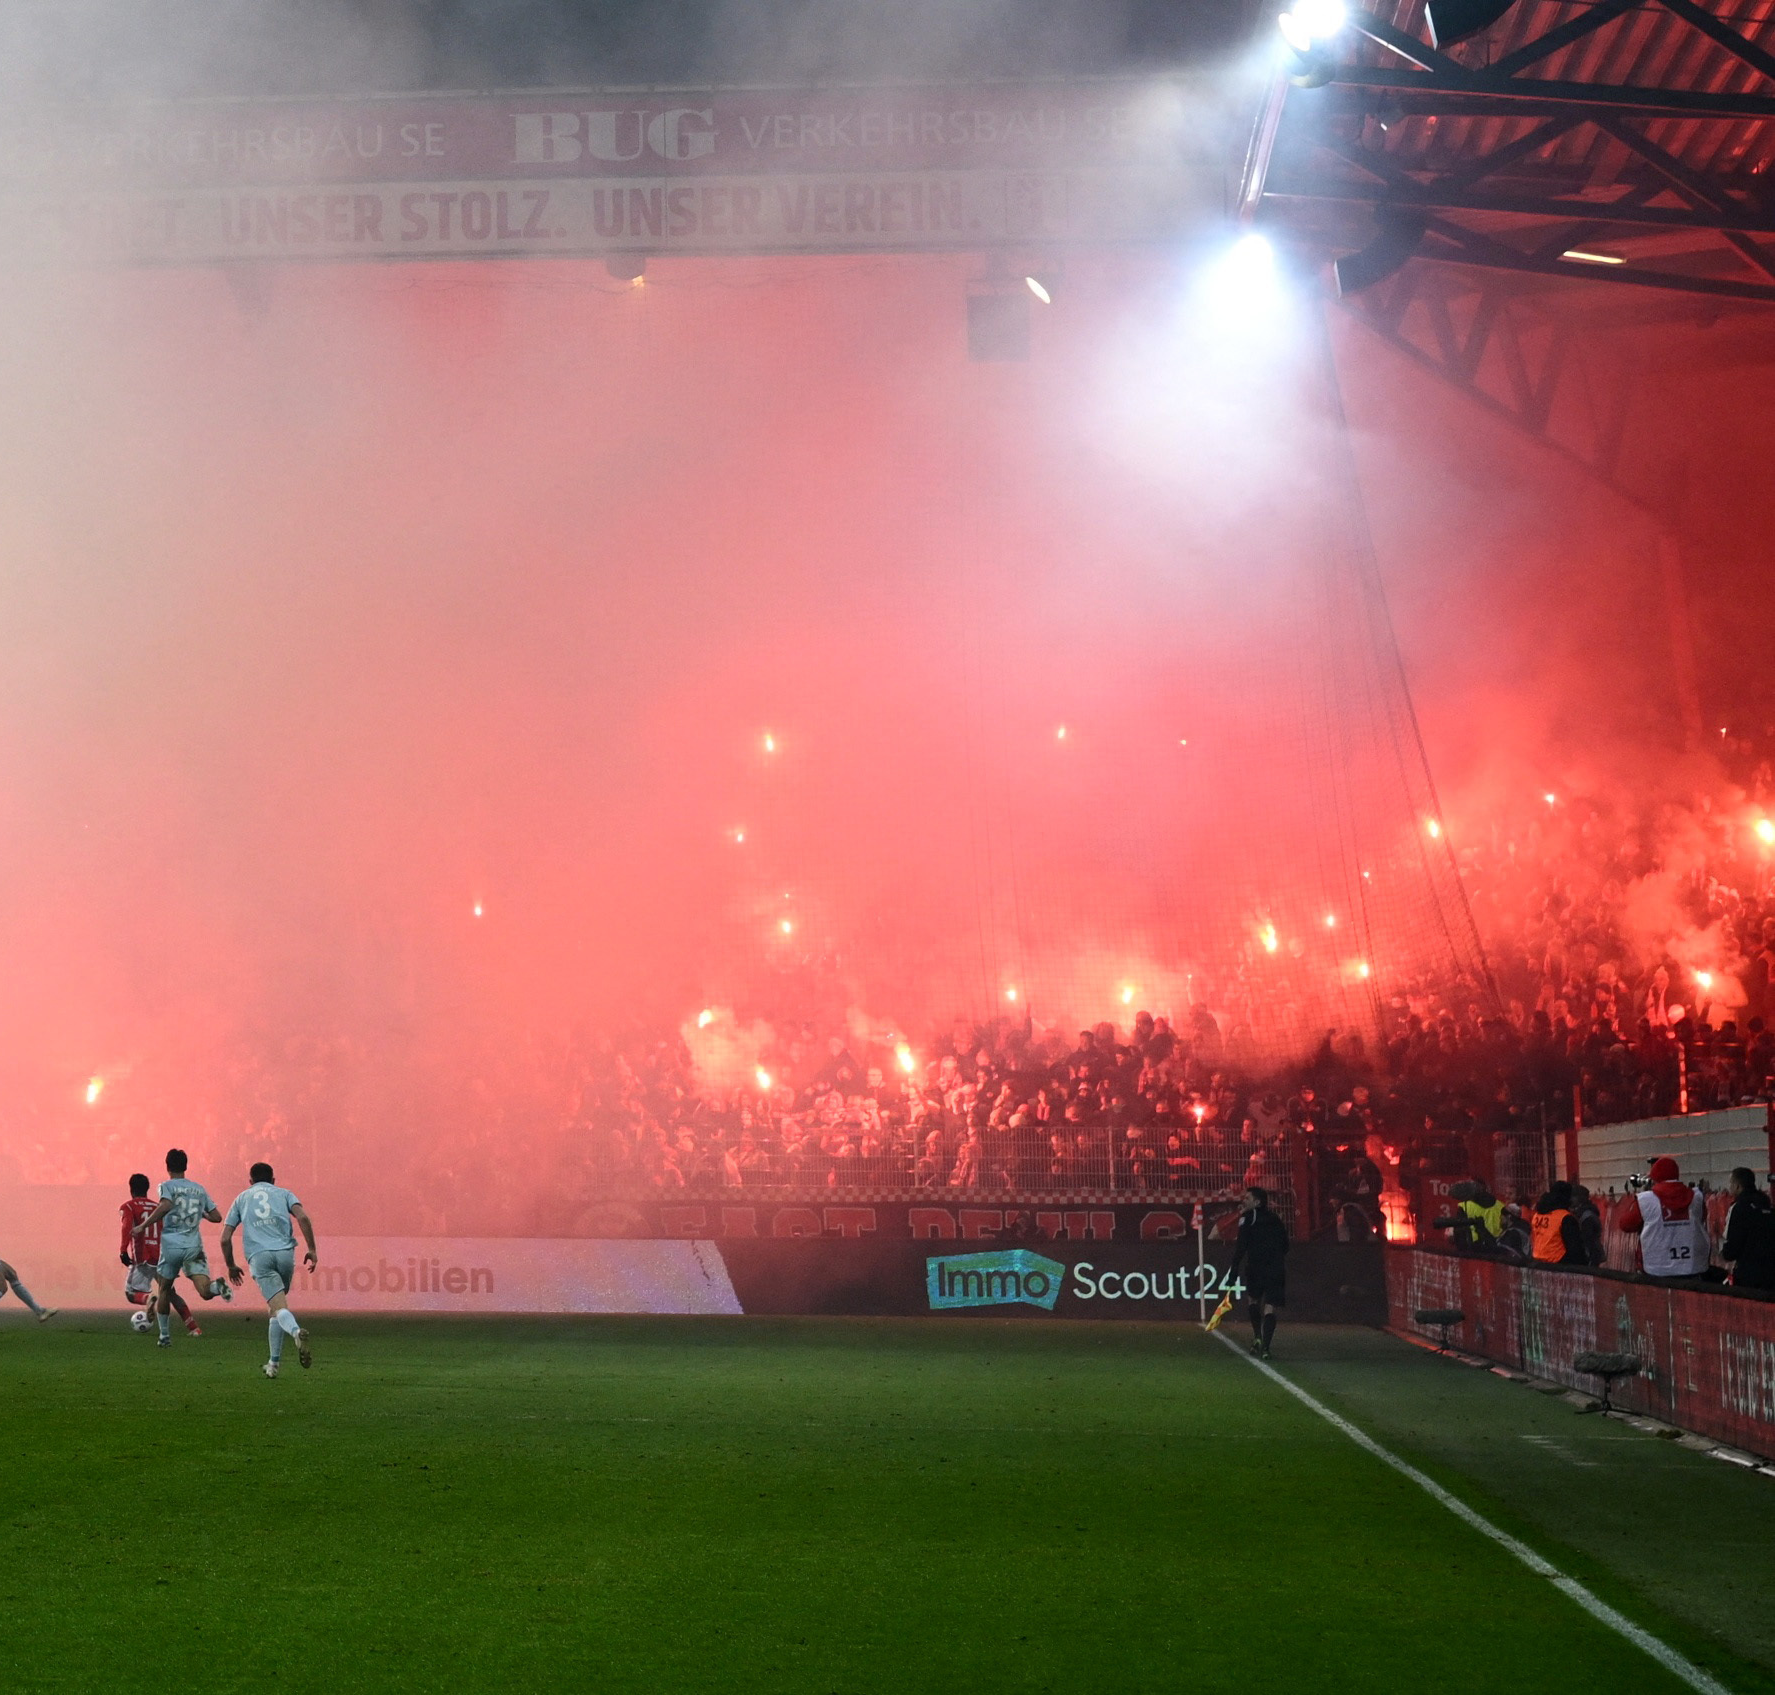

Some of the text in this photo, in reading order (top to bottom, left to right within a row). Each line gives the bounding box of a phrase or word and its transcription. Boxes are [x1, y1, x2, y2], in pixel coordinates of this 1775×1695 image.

[400, 122, 446, 159] SE
[508, 106, 719, 165] BUG
[739, 105, 1065, 151] VERKEHRSBAU
[220, 191, 385, 247] UNSER
[398, 189, 568, 244] STOLZ.
[592, 180, 984, 240] UNSER VEREIN.
[253, 1190, 271, 1220] 3
[1429, 1179, 1450, 1197] To
[1669, 1246, 1691, 1260] 12
[937, 1261, 1247, 1301] Immo Scout24
